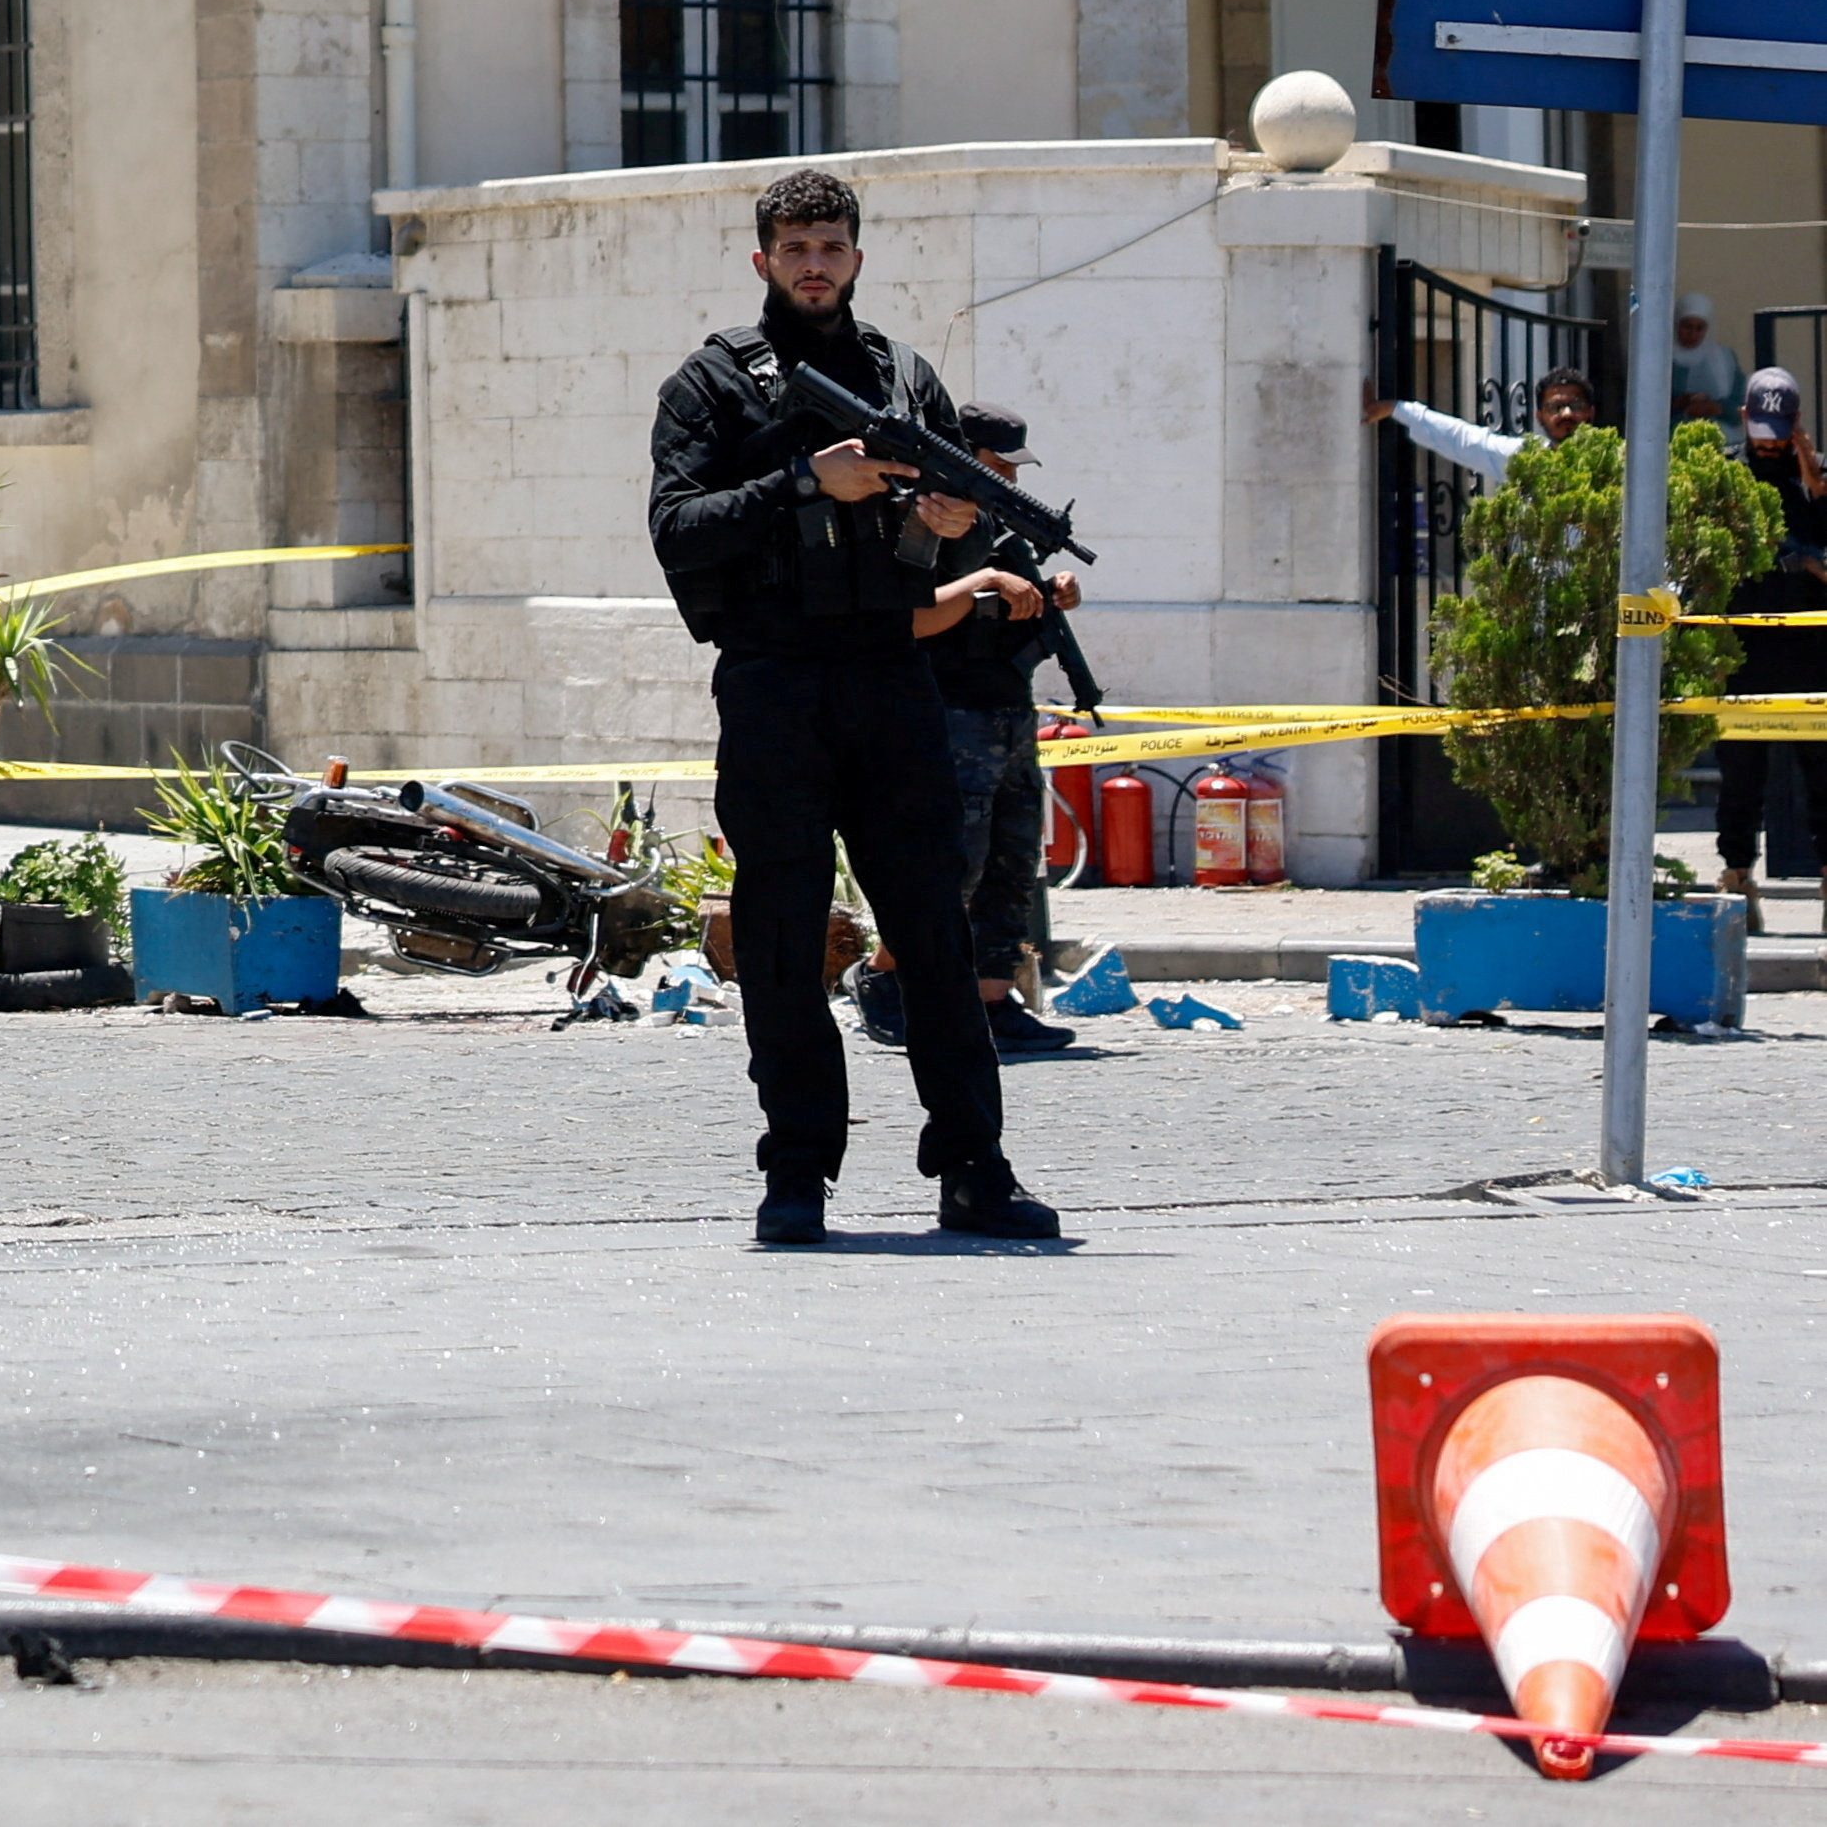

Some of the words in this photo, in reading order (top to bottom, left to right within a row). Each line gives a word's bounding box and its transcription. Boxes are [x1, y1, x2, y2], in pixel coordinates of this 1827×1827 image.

[1401, 712, 1448, 725] POLICE
[1259, 728, 1276, 739] NO
[1278, 725, 1312, 737] ENTRY
[1140, 738, 1183, 751] POLICE
